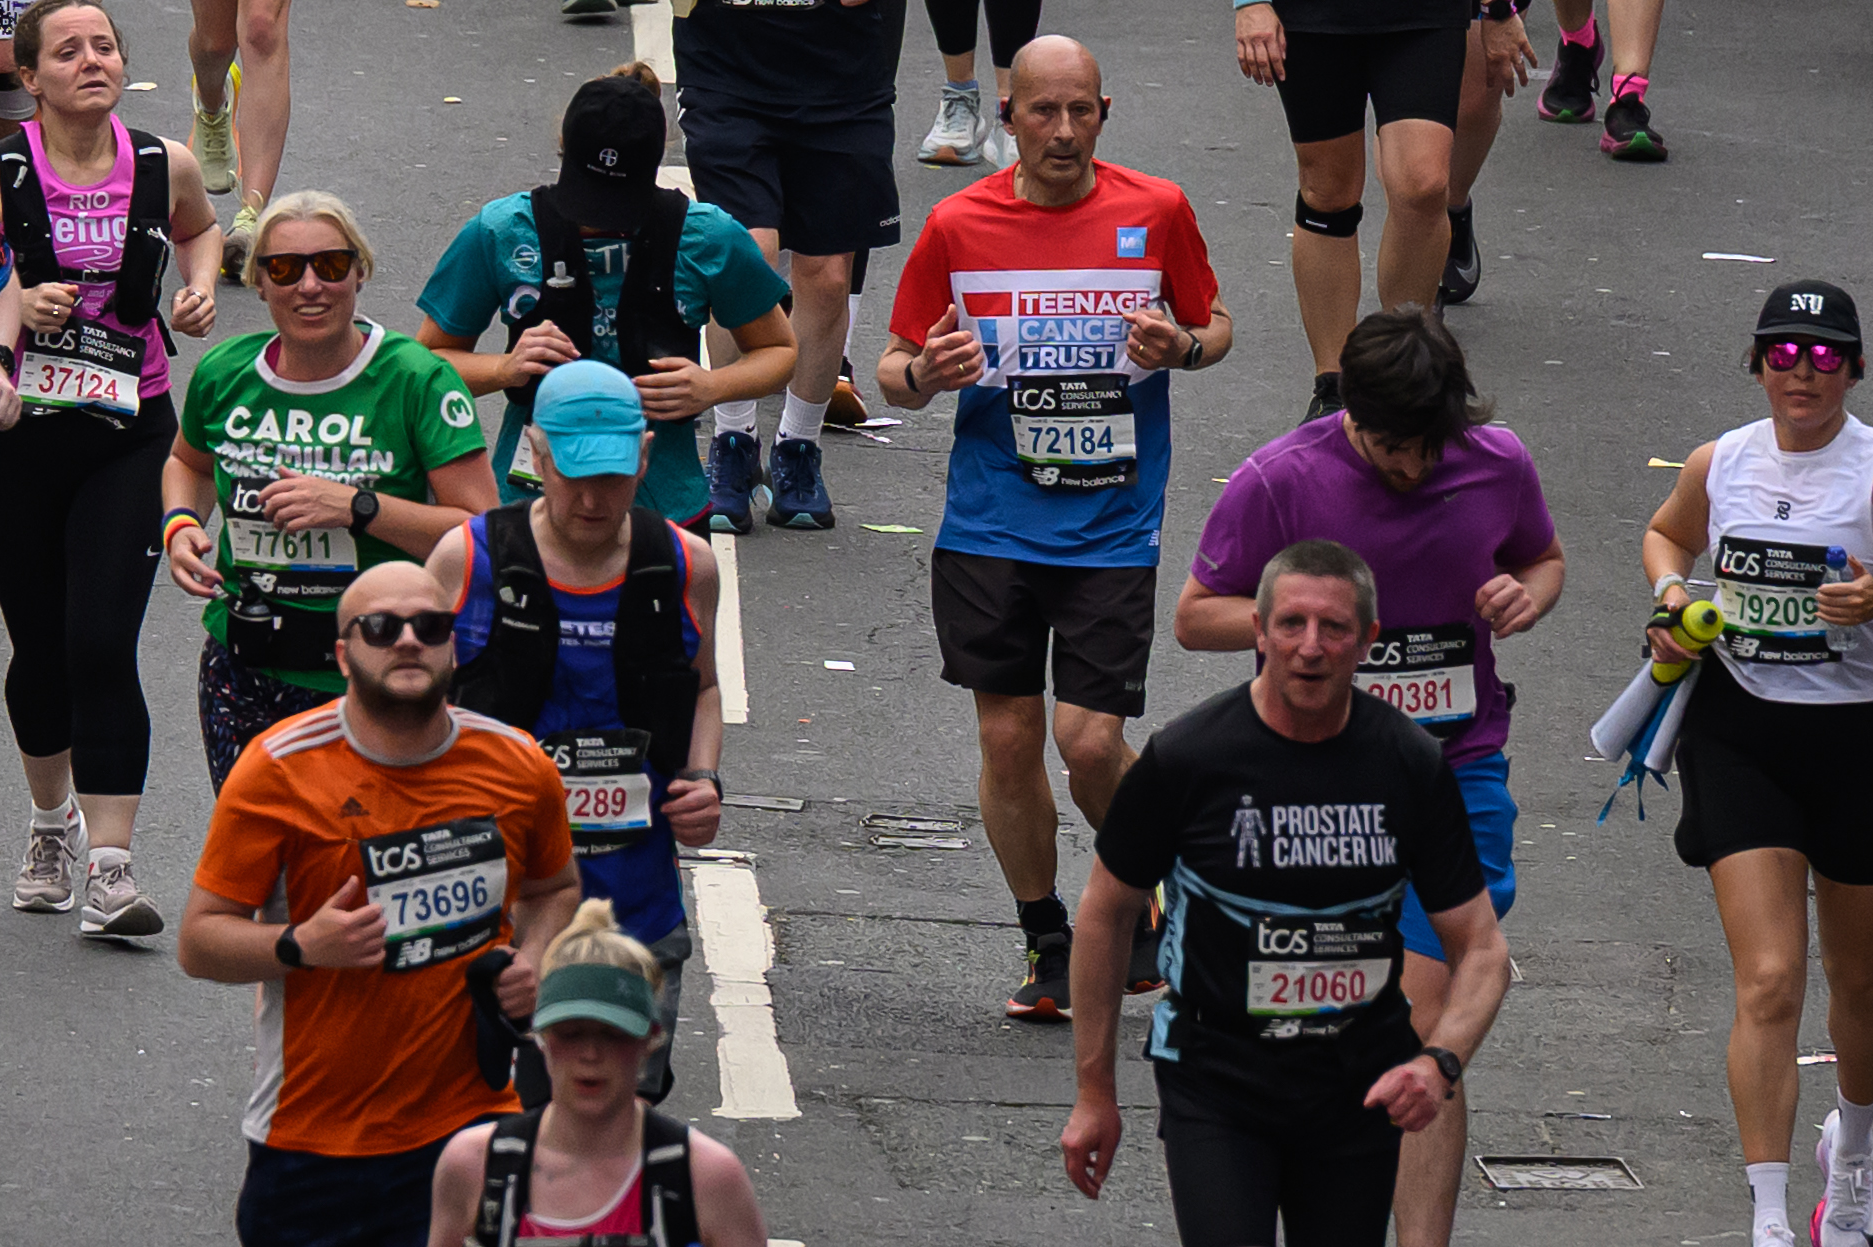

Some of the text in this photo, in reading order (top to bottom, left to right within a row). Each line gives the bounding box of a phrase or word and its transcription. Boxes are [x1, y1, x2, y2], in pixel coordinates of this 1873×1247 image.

[69, 192, 111, 210] RIO
[1020, 292, 1151, 314] TEENAGE
[82, 326, 107, 339] TATA
[80, 335, 137, 358] CONSULTANCY
[80, 345, 114, 362] SERVICES
[1022, 346, 1114, 369] TRUST
[39, 364, 119, 402] 37124
[1060, 382, 1087, 390] TATA
[1013, 389, 1056, 411] tcs
[1060, 391, 1122, 401] CONSULTANCY
[1060, 401, 1102, 410] SERVICES
[225, 406, 372, 445] CAROL
[1028, 426, 1114, 454] 72184
[215, 440, 394, 473] MACMILLAN
[1082, 474, 1125, 487] balance
[249, 530, 330, 560] 77611
[1766, 548, 1793, 559] TATA
[1721, 545, 1760, 577] tcs
[1764, 569, 1807, 582] SERVICES
[1734, 591, 1819, 627] 79209
[1407, 633, 1434, 642] TATA
[1407, 640, 1467, 653] CONSULTANCY
[1407, 653, 1445, 664] SERVICES
[576, 738, 605, 747] TATA
[577, 758, 620, 769] SERVICES
[1272, 805, 1385, 836] PROSTATE
[421, 829, 451, 841] TATA
[424, 831, 492, 854] CONSULTANCY
[368, 840, 422, 877] tcs
[1274, 836, 1397, 866] CANCER UK
[391, 876, 488, 926] 73696
[1258, 922, 1308, 954] tcs
[1314, 923, 1345, 932] TATA
[1314, 932, 1383, 942] CONSULTANCY
[1271, 970, 1366, 1004] 21060
